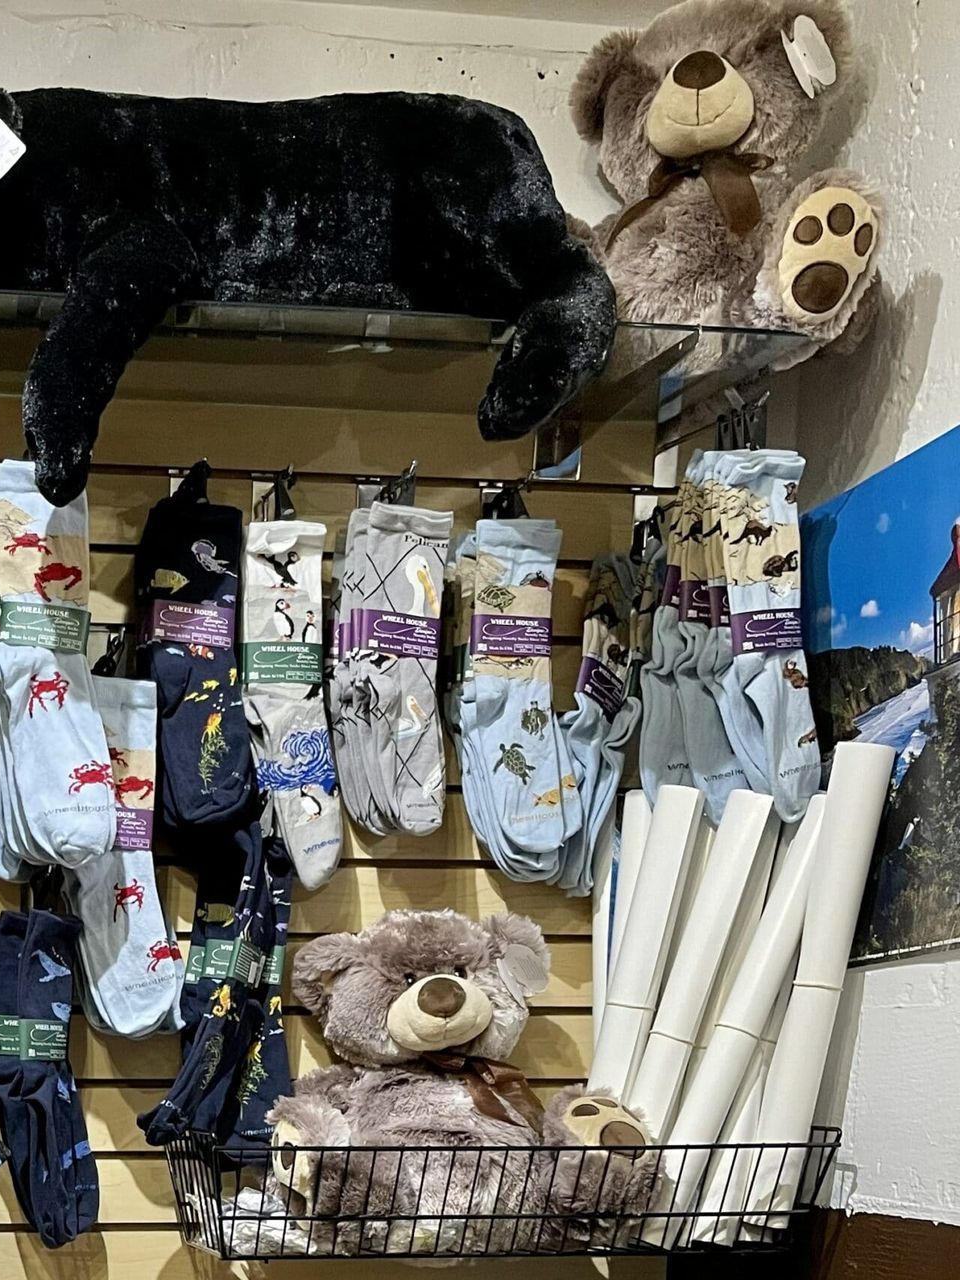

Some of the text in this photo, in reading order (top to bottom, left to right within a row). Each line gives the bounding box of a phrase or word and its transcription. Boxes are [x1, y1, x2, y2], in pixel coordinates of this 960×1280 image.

[17, 606, 69, 617] WHEEL HOUSE
[169, 605, 218, 616] WHEEL HOUSE
[515, 619, 539, 627] HOUSE
